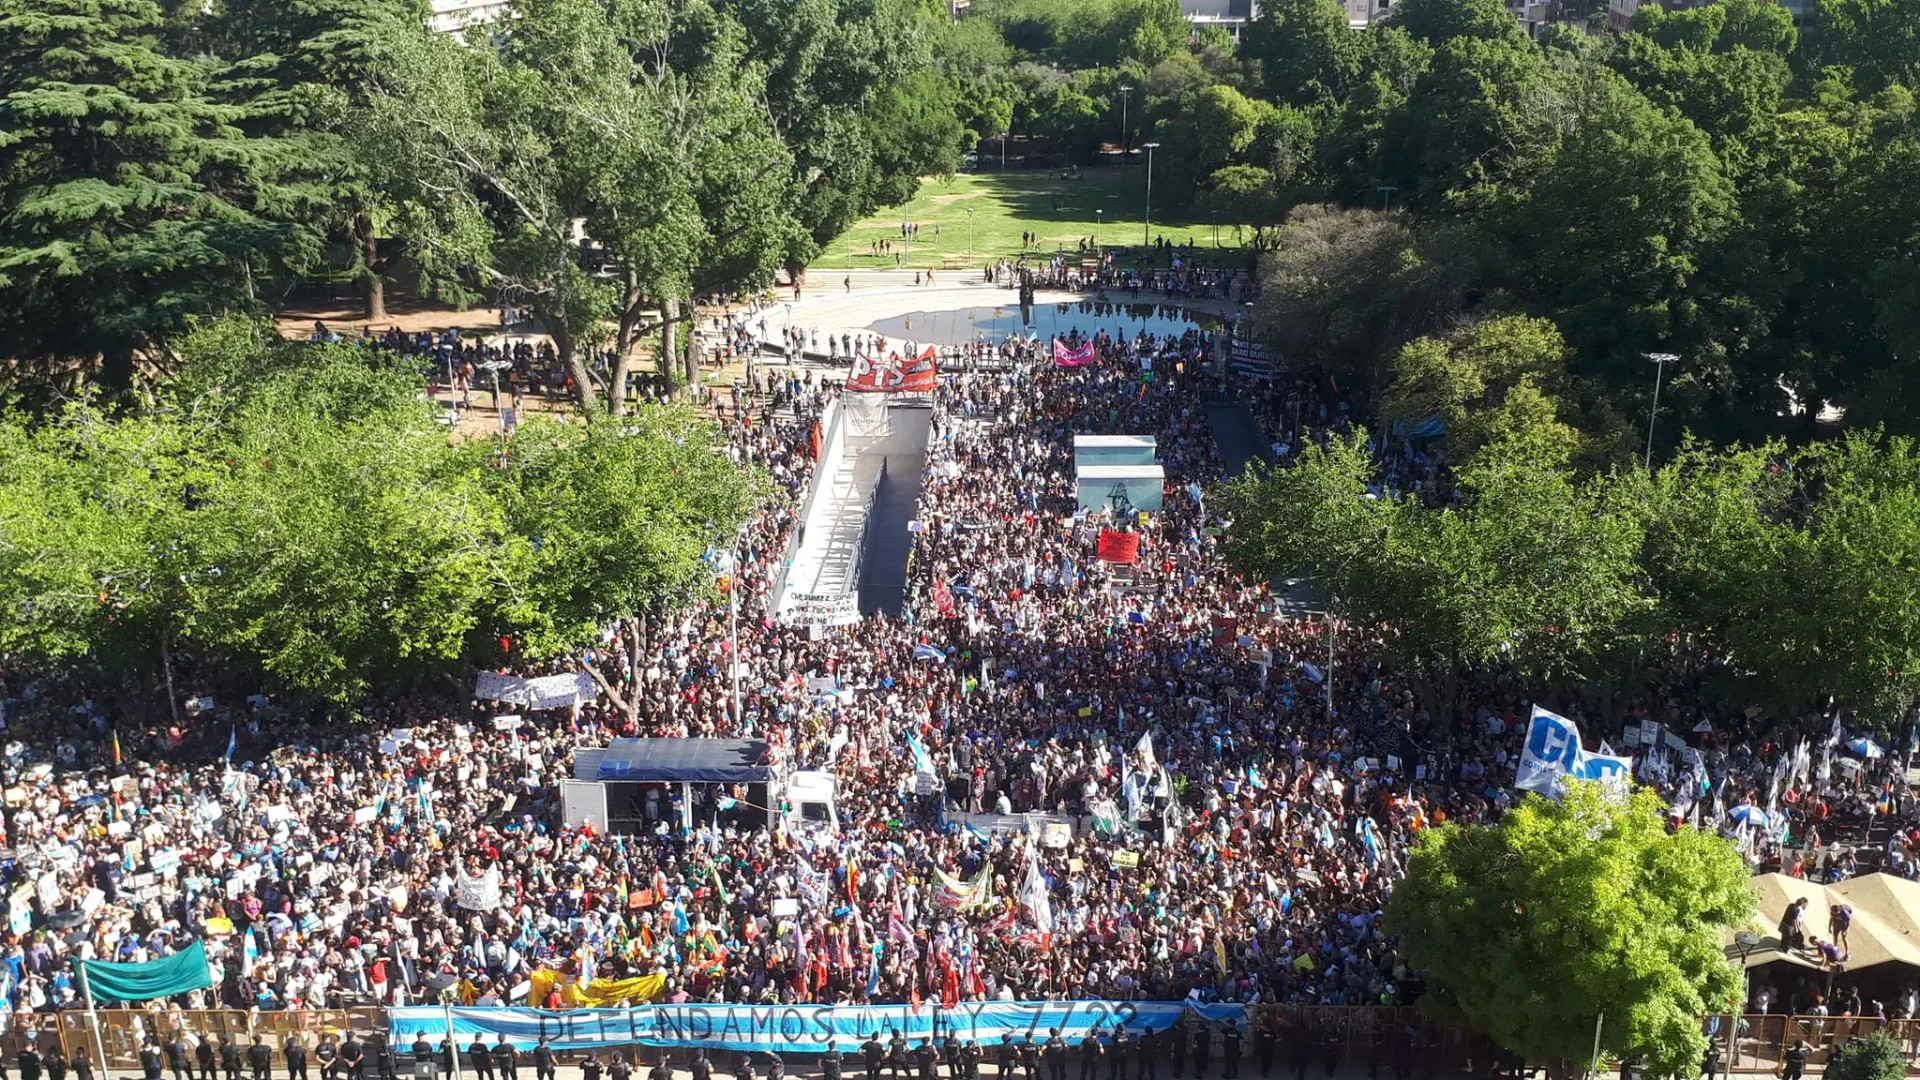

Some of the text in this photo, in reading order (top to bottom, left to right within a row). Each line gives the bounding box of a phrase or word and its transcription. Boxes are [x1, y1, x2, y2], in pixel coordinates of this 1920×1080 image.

[850, 353, 905, 387] PTS
[540, 1007, 835, 1043] DEFENDAMOS
[856, 1013, 894, 1042] LA
[901, 1005, 981, 1041] LEY
